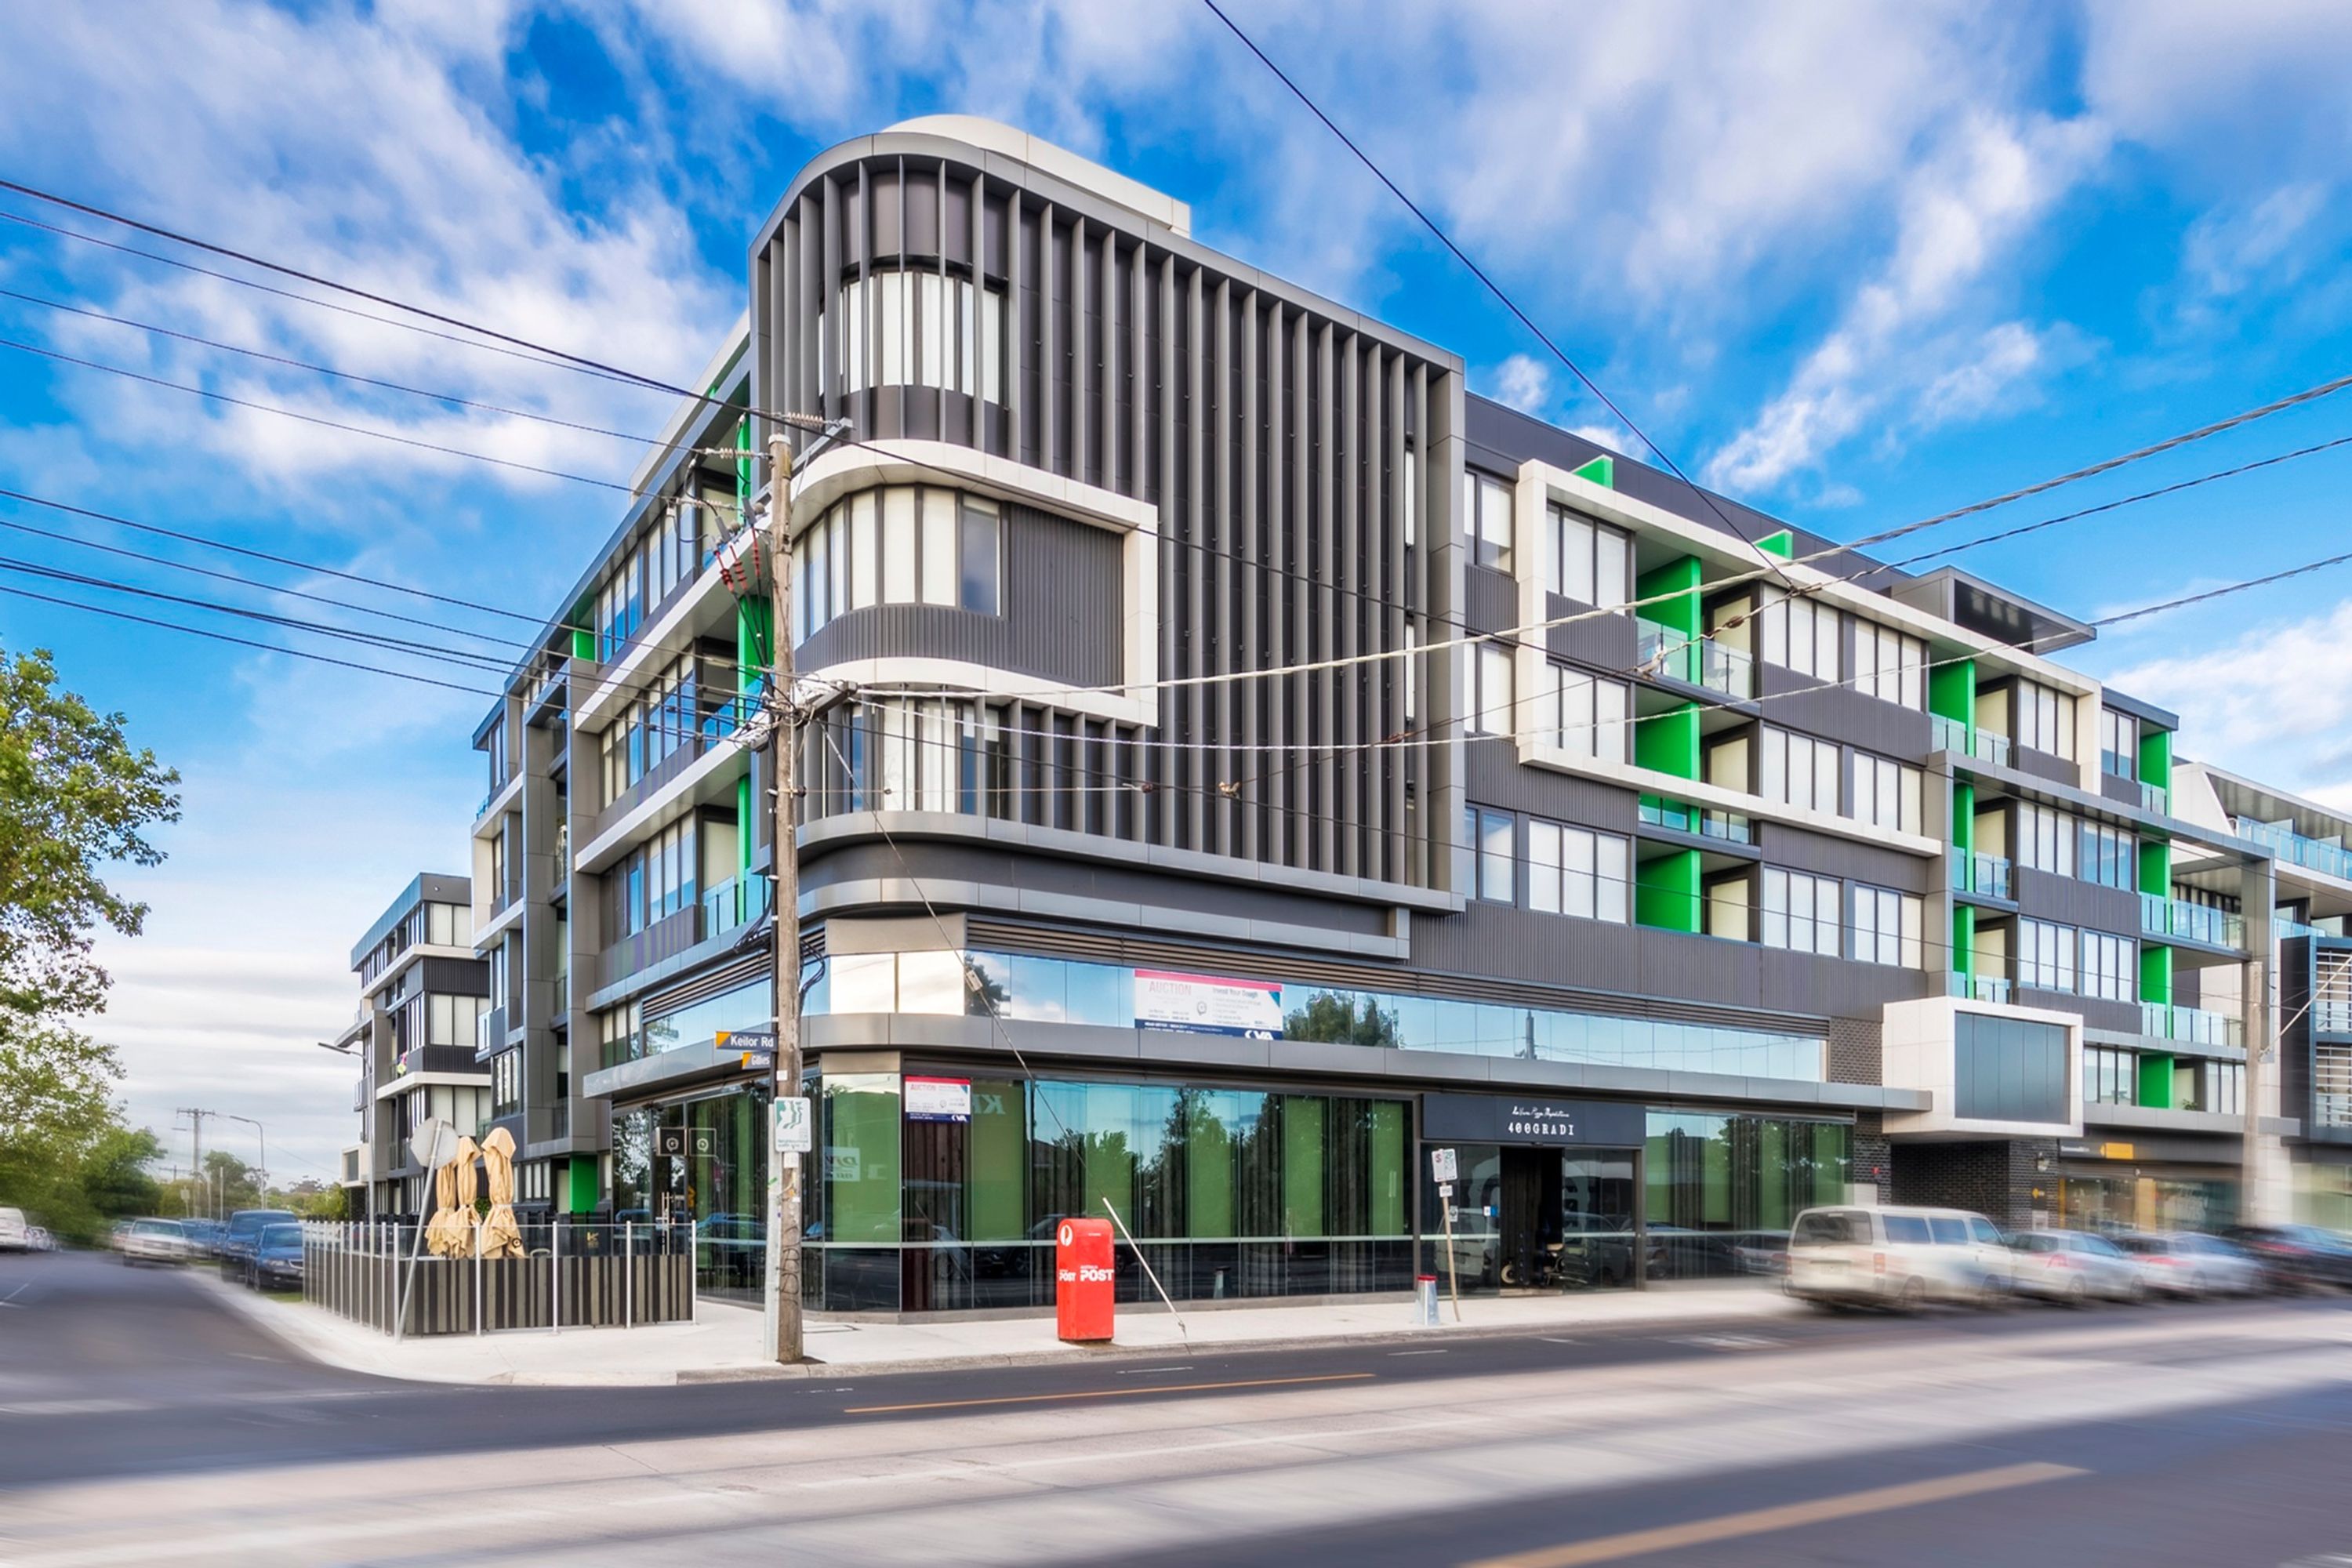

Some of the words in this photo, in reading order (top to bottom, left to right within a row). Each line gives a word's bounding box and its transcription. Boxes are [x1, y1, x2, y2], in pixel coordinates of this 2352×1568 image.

[1149, 981, 1192, 996] AUCTION
[730, 1035, 758, 1047] Keilor
[761, 1036, 774, 1047] Rd
[1508, 1122, 1574, 1136] 400GRADI
[1058, 1272, 1076, 1283] POST
[1080, 1269, 1115, 1283] POST
